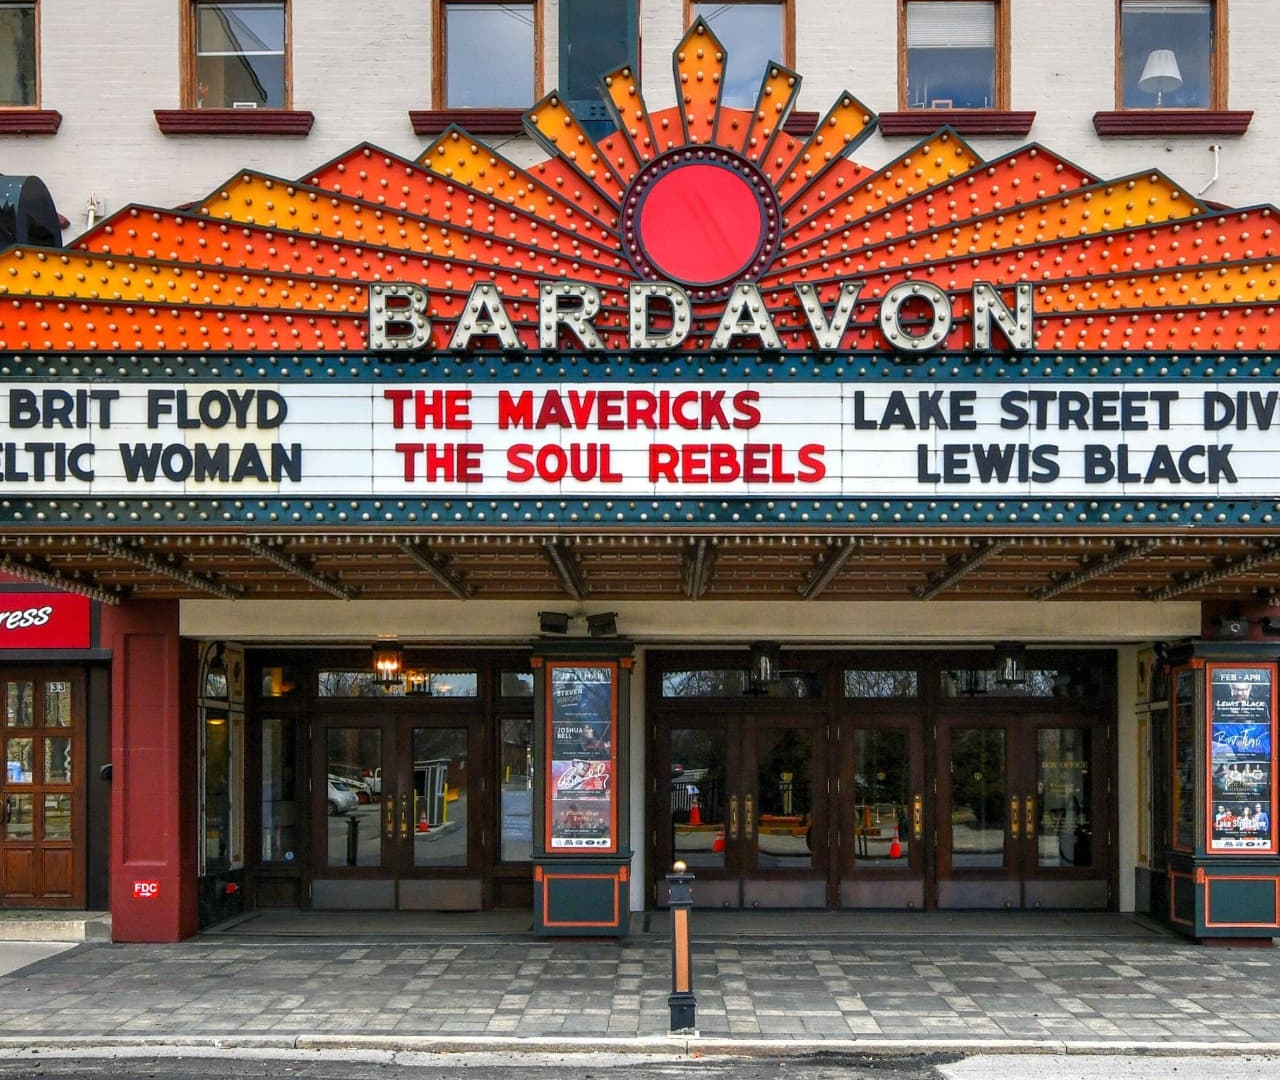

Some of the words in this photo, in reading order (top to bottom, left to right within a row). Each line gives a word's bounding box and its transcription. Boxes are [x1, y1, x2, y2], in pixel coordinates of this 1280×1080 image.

[368, 279, 1036, 353] BARDAVON
[8, 389, 121, 430] BRIT
[147, 389, 289, 430] FLOYD
[383, 389, 472, 430] THE
[498, 389, 762, 431] MAVERICKS
[853, 390, 977, 431] LAKE
[1000, 390, 1179, 431] STREET
[120, 442, 303, 483] WOMAN
[395, 442, 485, 483] THE
[505, 442, 623, 483] SOUL
[648, 442, 826, 484] REBELS
[918, 443, 1061, 484] LEWIS
[1084, 443, 1239, 484] BLACK
[50, 682, 65, 692] 33
[134, 883, 159, 893] FDC
